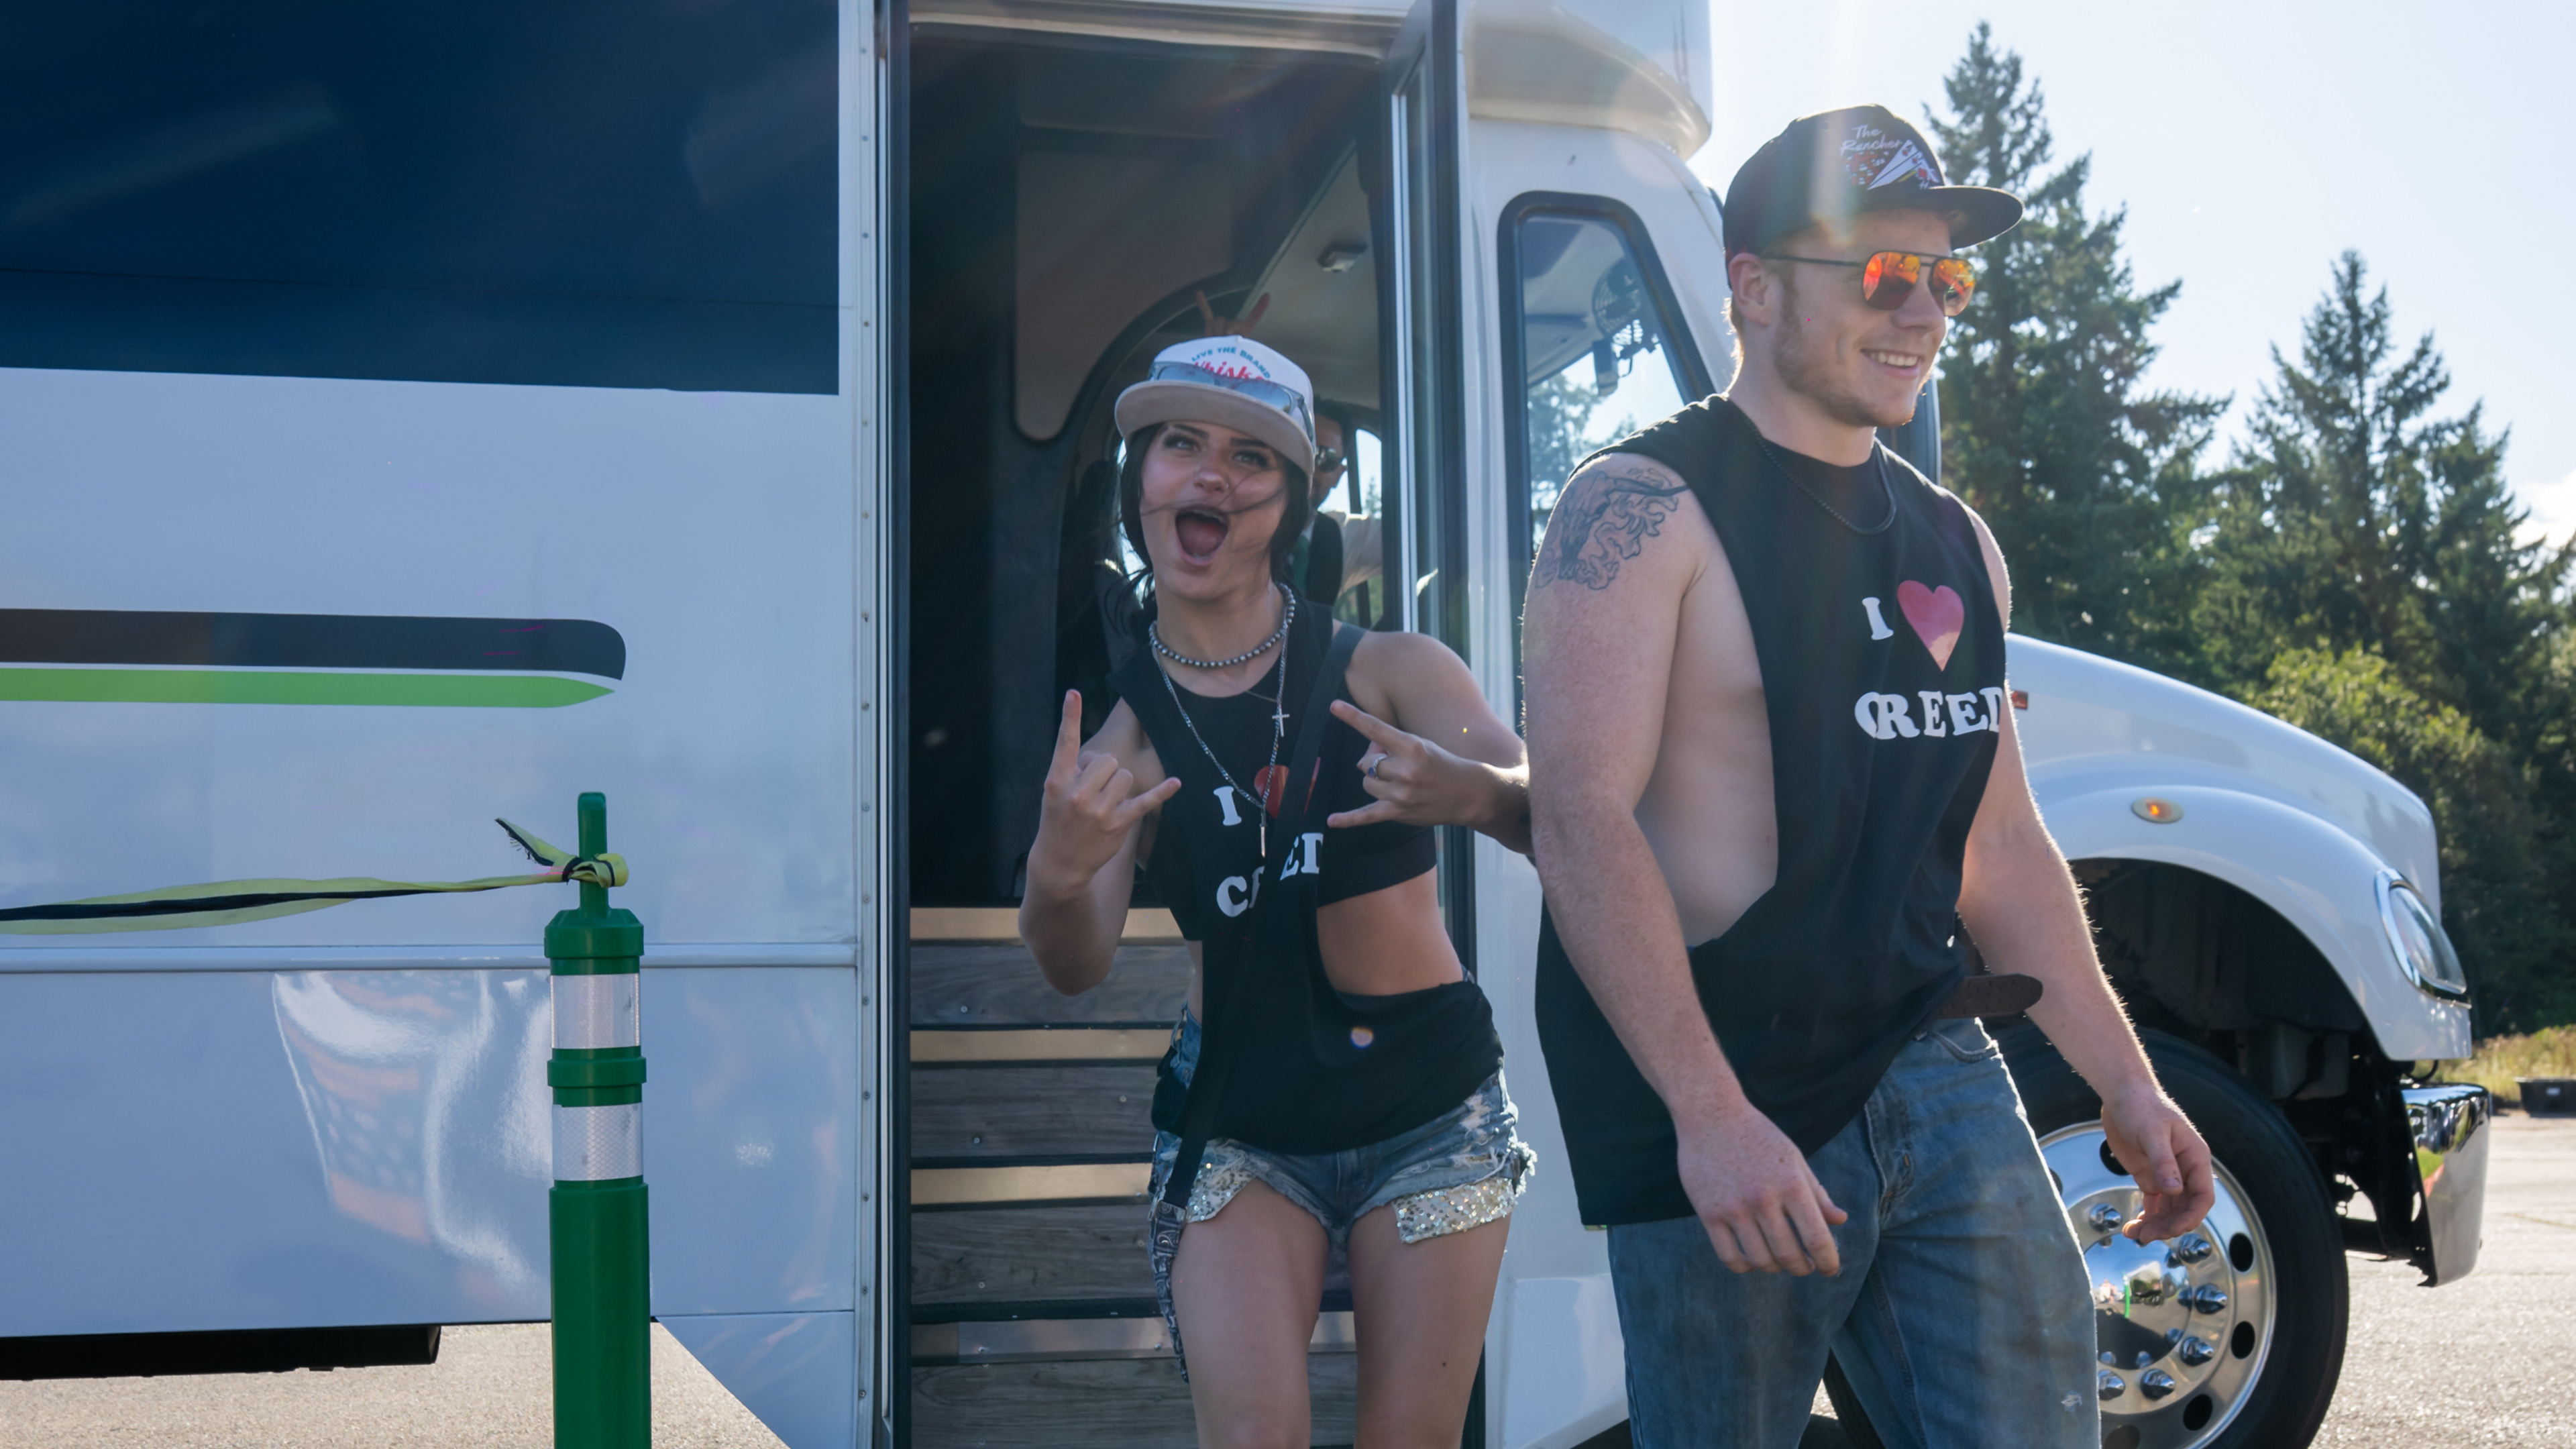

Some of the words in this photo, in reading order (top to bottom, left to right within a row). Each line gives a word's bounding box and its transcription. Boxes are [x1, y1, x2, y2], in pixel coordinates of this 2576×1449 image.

[1839, 133, 1903, 156] Rancher
[1851, 124, 1882, 140] The
[1191, 350, 1213, 362] LIVE
[1217, 346, 1236, 354] THE
[1239, 350, 1271, 379] BRAND
[1862, 596, 1894, 640] I
[1213, 786, 1242, 826] I
